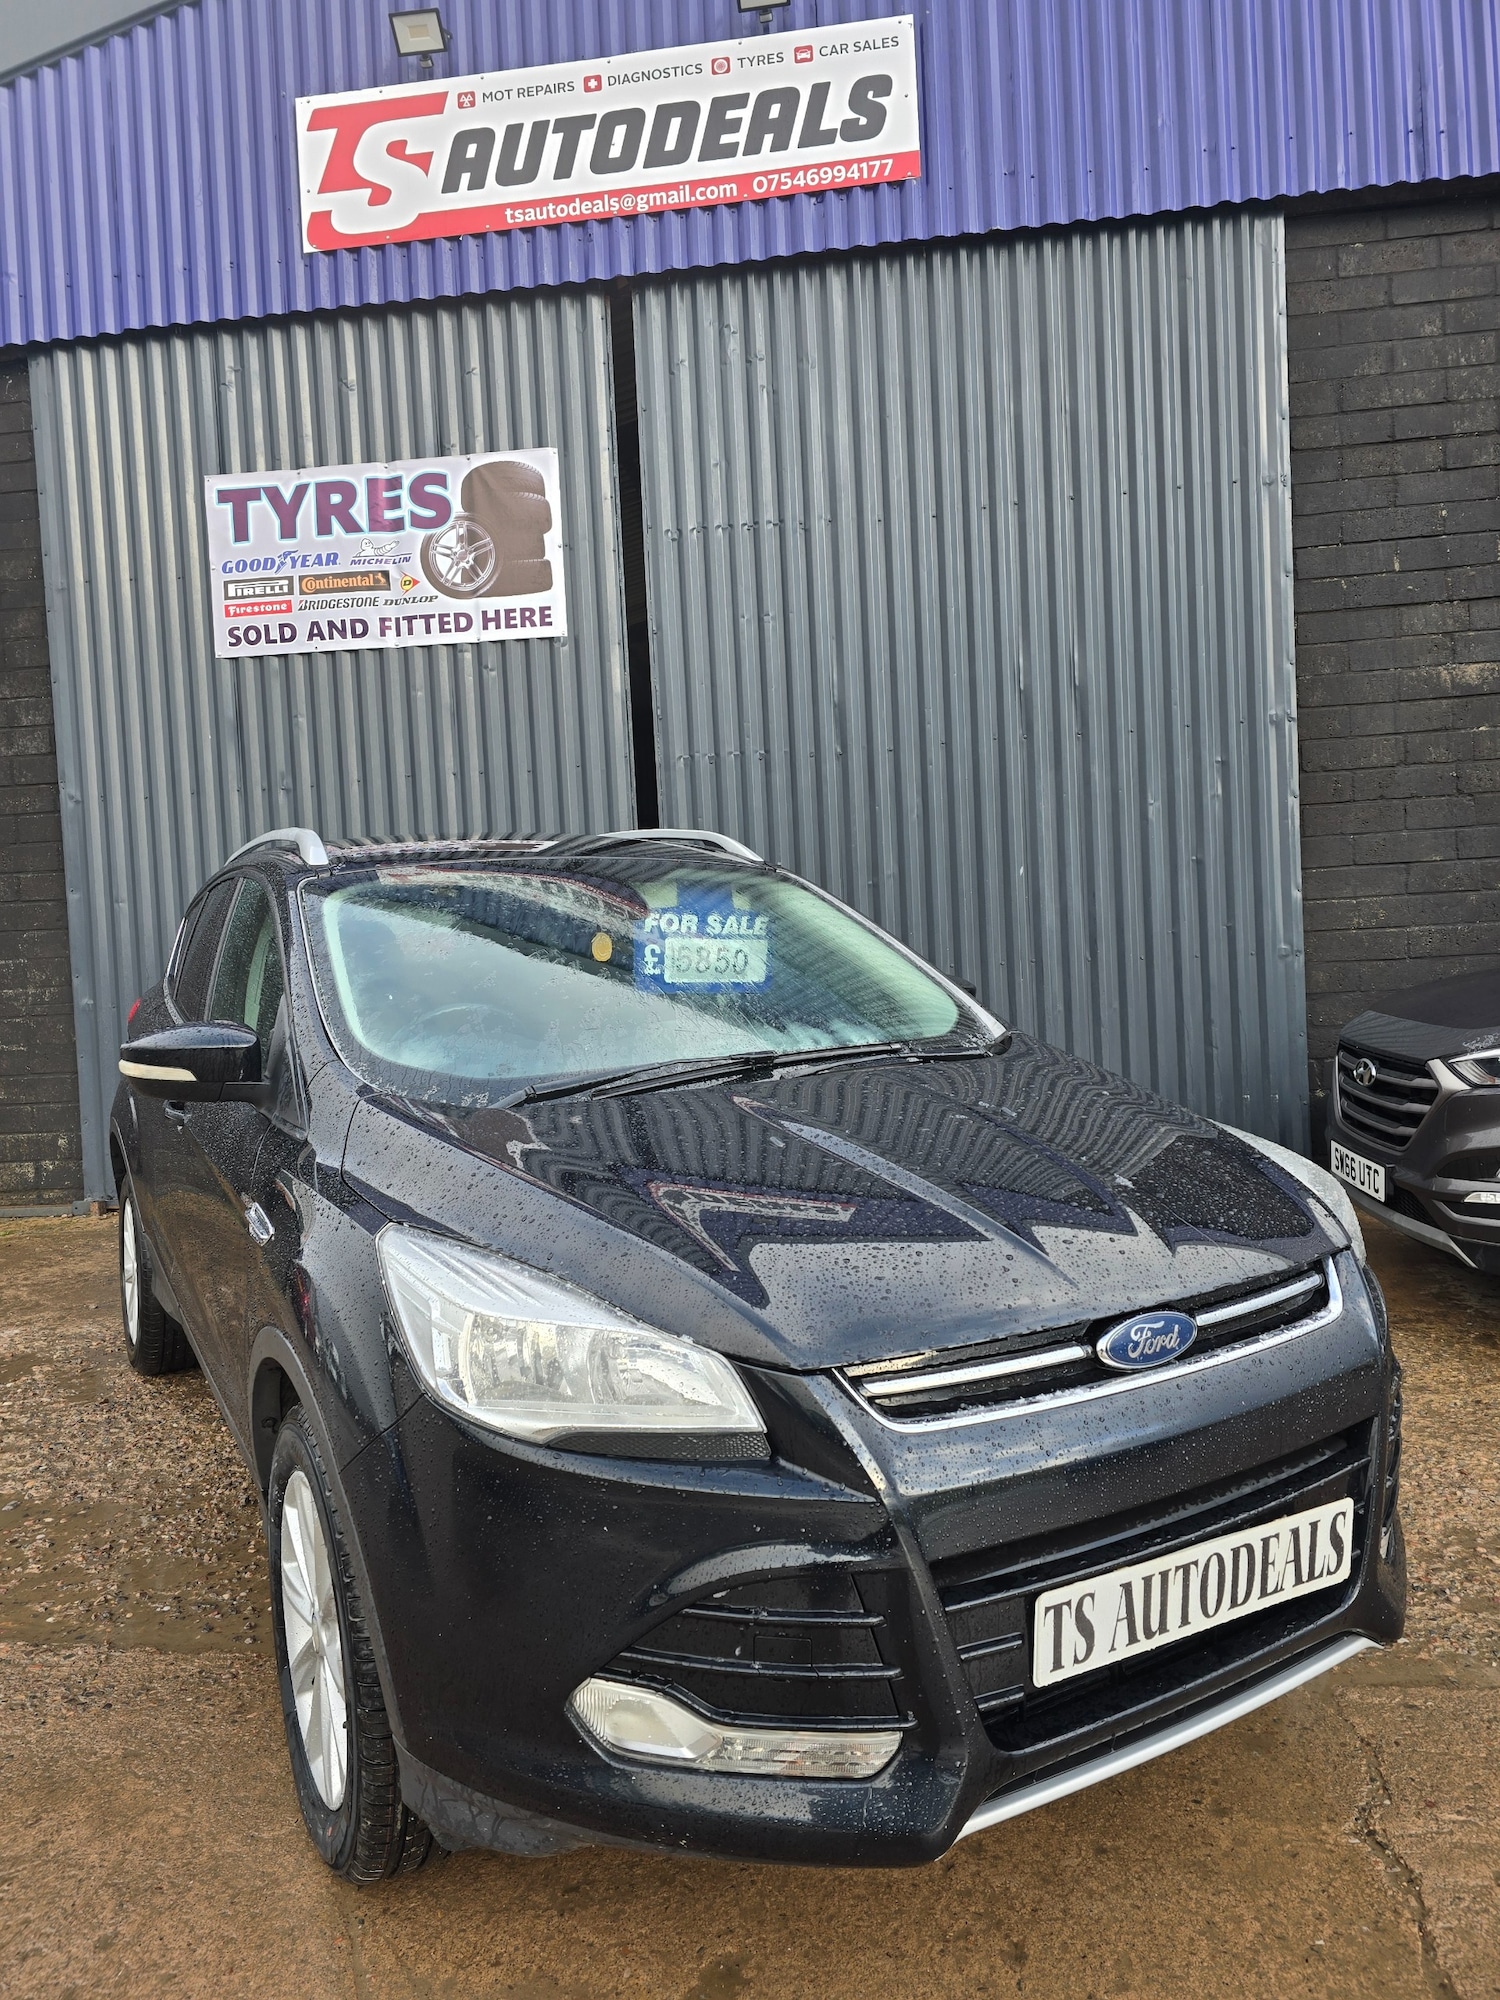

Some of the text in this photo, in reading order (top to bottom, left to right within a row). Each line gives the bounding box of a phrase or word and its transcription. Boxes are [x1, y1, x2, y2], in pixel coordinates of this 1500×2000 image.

[819, 36, 899, 58] CAR SALES
[737, 52, 784, 69] TYRES
[607, 63, 703, 87] DIAGNOSTICS
[482, 80, 575, 103] MOT REPAIRS
[306, 74, 893, 236] TS AUTODEALS
[505, 158, 893, 224] tsautodeals@gmail.com 07546994177
[217, 471, 452, 543] TYRES
[350, 556, 411, 566] MICHELIN
[228, 580, 289, 597] PIRELLI
[301, 573, 374, 593] Continental
[228, 603, 287, 617] Firestone
[298, 596, 380, 612] BRIDGESTONE
[383, 595, 438, 606] DUNLOP
[228, 606, 553, 647] SOLD AND FITTED HERE
[644, 913, 769, 935] FOR SALE
[1358, 1160, 1380, 1194] UTC
[1127, 1320, 1180, 1358] Ford
[1044, 1511, 1348, 1673] TS AUTODEALS
